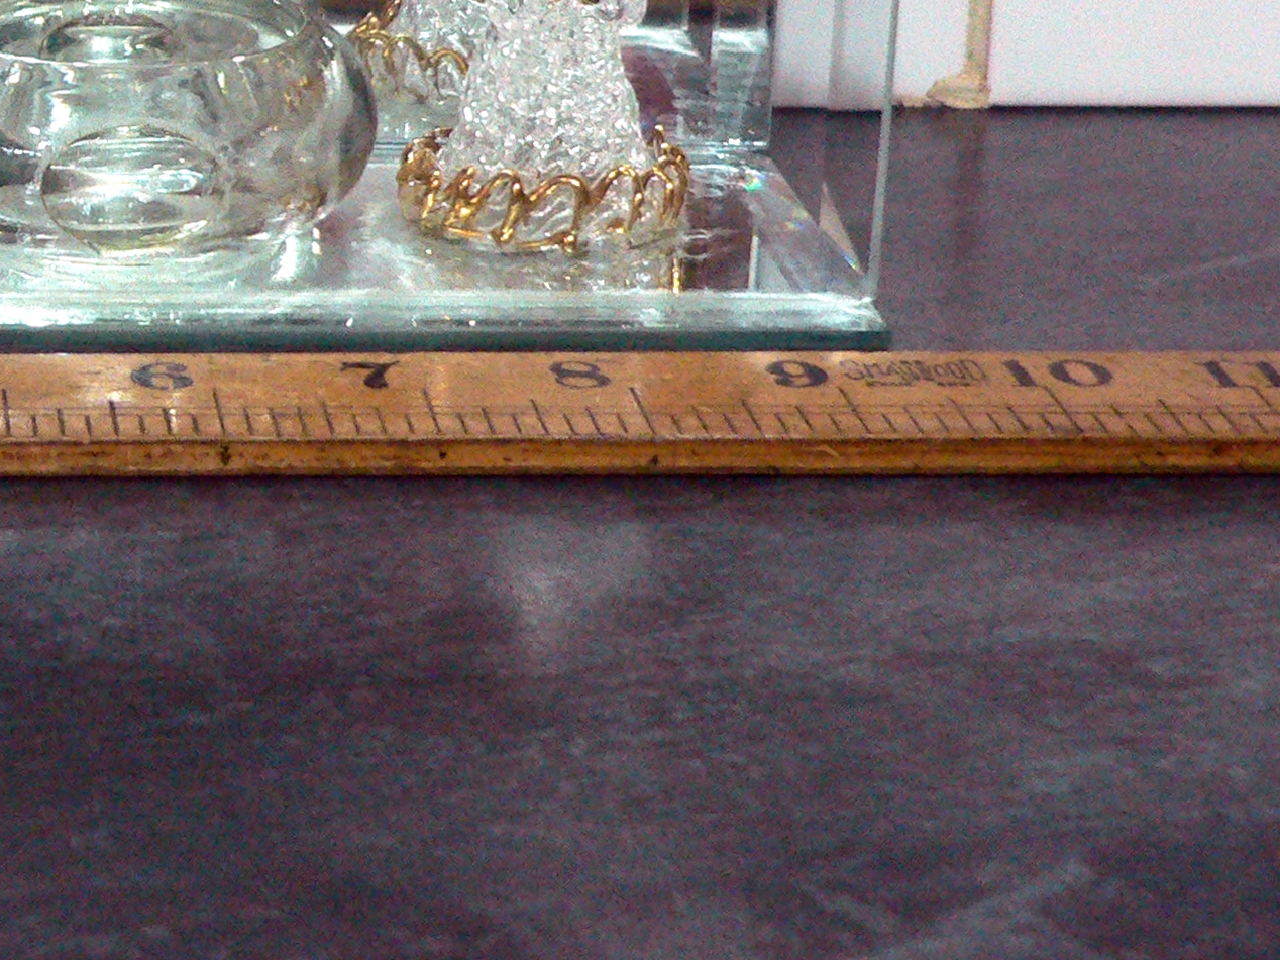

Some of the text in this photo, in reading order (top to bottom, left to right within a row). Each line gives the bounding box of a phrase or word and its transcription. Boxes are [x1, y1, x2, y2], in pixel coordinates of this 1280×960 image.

[130, 361, 194, 391] 6
[340, 360, 401, 389] 7
[548, 360, 613, 390] 8
[764, 358, 830, 388] 9
[1001, 358, 1114, 389] 10
